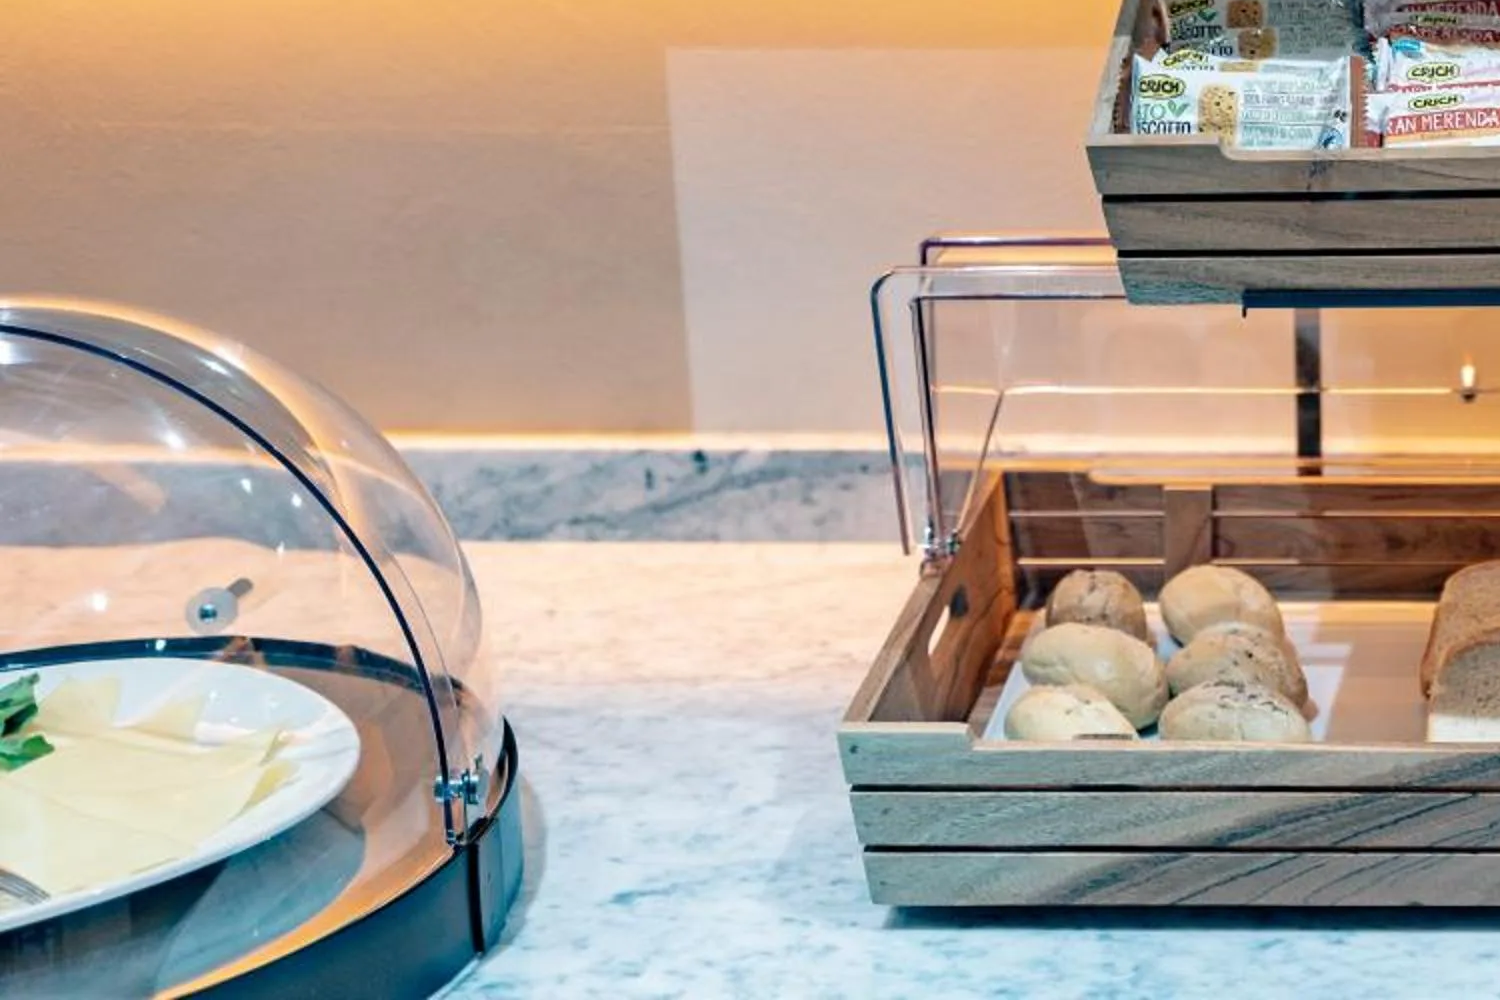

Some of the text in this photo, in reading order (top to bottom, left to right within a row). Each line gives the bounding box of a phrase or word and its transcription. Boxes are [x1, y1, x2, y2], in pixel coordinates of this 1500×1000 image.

[1411, 66, 1455, 78] CRICH
[1139, 79, 1180, 94] CRICH
[1413, 95, 1458, 109] CRICH
[1421, 110, 1500, 131] MERENDA
